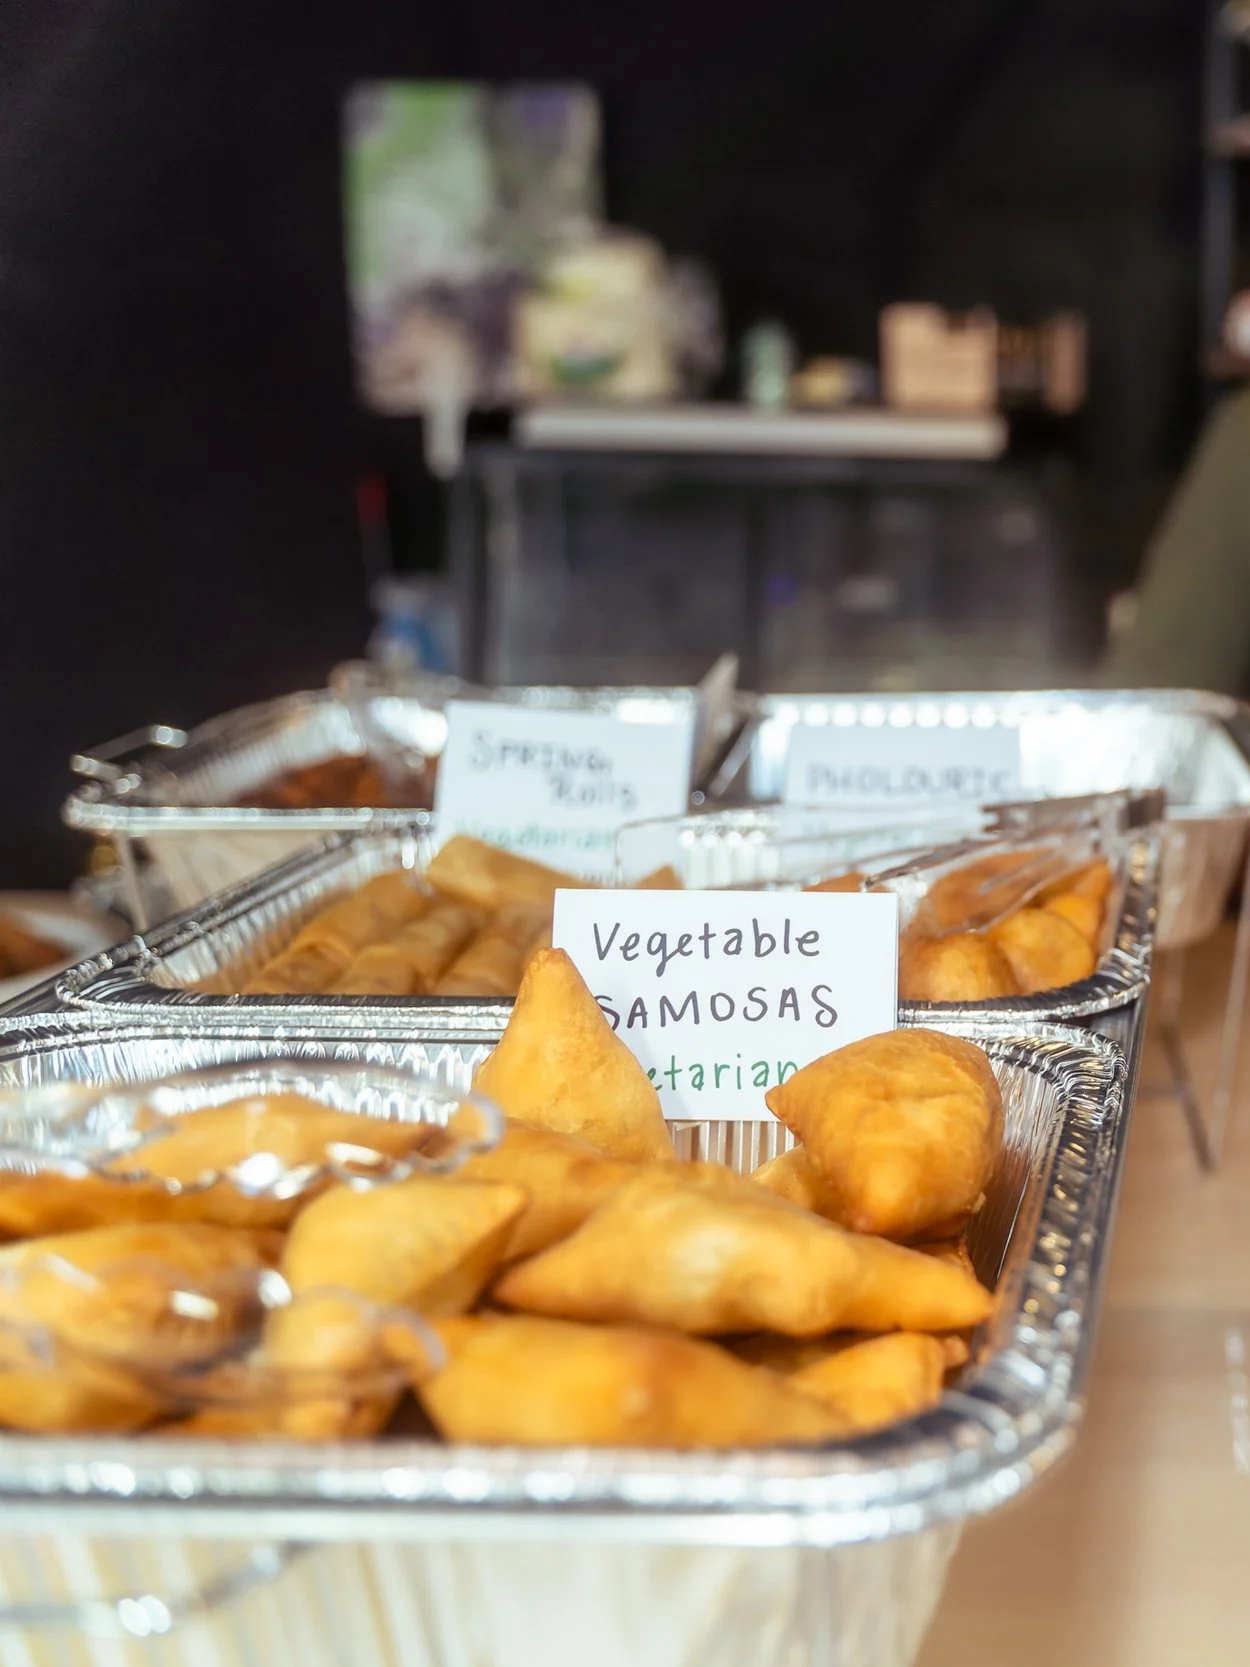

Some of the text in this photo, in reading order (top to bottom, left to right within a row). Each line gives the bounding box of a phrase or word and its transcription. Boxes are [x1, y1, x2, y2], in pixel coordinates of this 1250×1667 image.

[593, 918, 820, 978] Vegetable
[595, 984, 838, 1032] SAMOSAS
[646, 1053, 799, 1092] etarian
